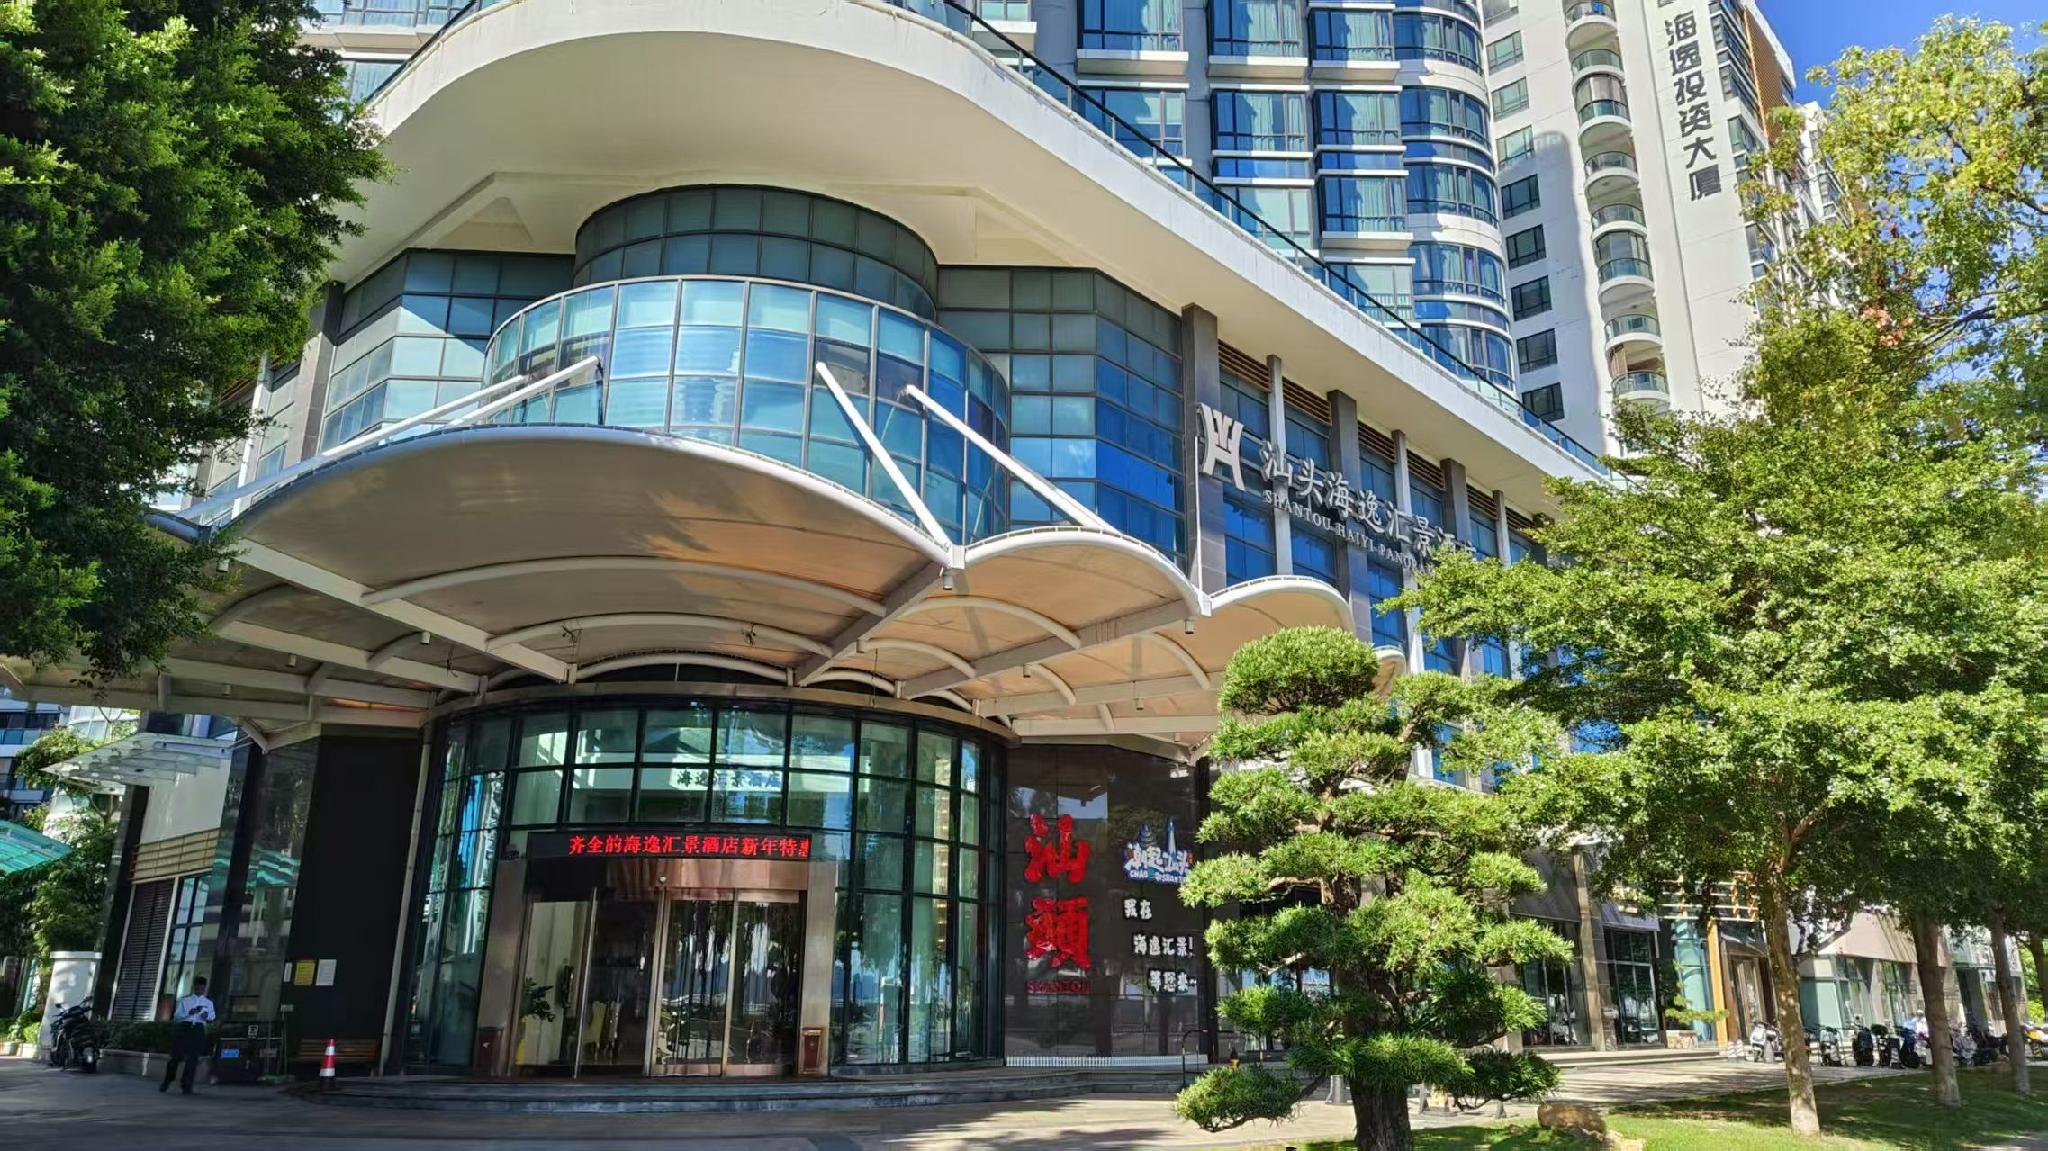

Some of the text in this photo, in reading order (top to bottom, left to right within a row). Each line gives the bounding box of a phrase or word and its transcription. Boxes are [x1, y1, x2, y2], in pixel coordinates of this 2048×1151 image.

[1665, 10, 1721, 202] 海逸投资大厦
[1259, 441, 1477, 558] 汕头海逸汇景
